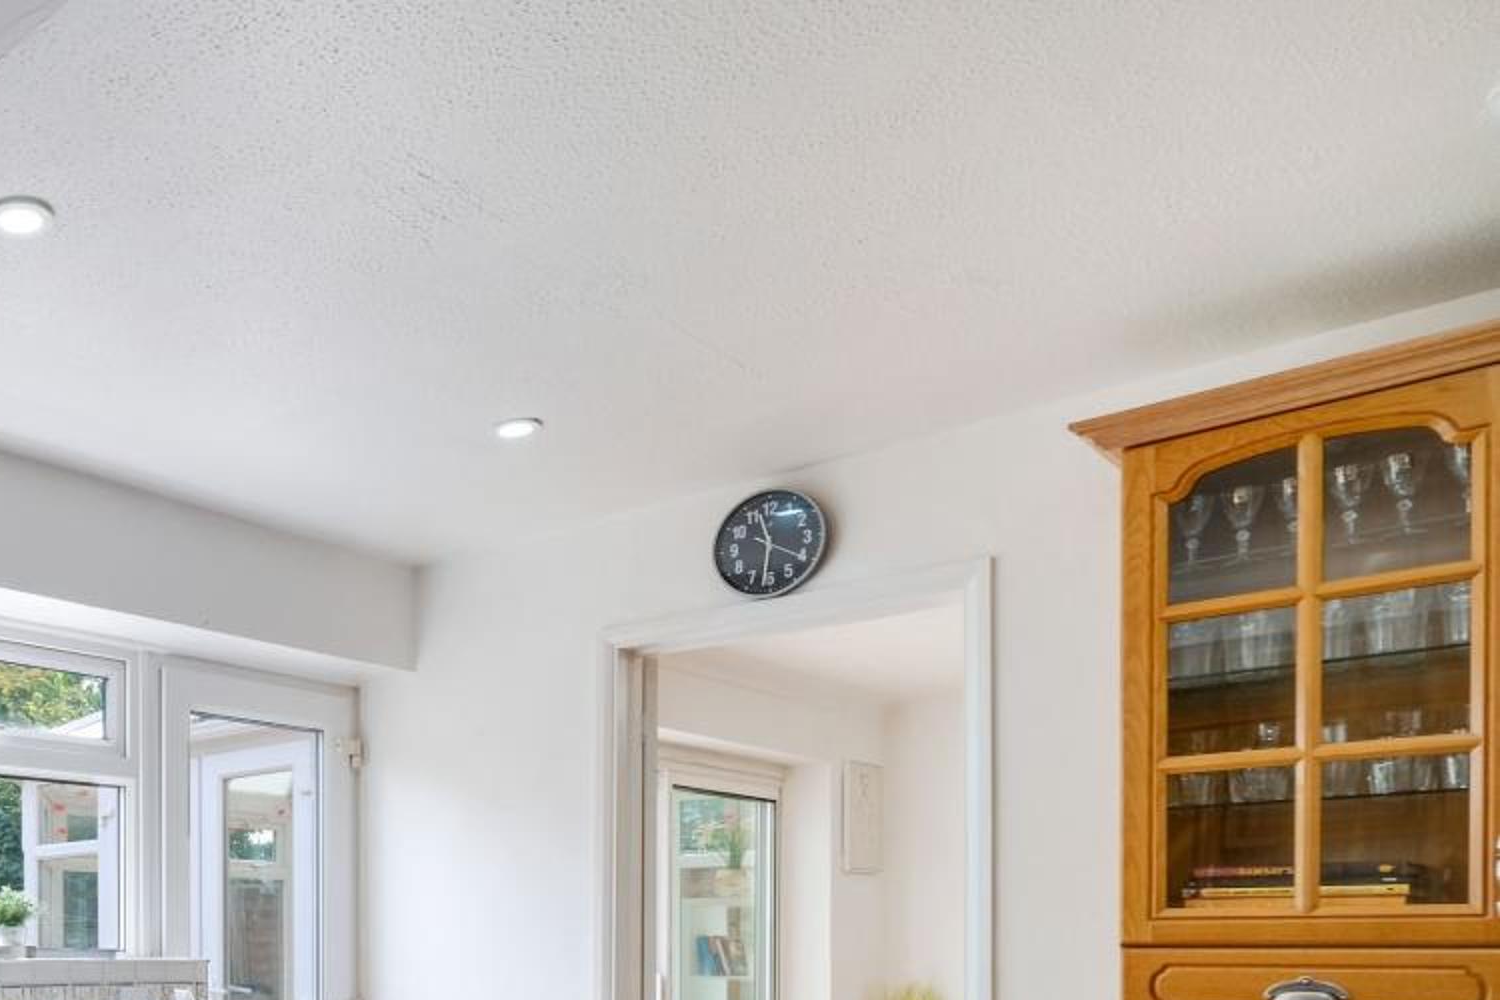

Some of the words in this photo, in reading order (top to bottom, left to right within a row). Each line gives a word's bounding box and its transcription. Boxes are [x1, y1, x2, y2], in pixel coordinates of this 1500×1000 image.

[746, 509, 759, 525] 11
[798, 513, 807, 527] 2
[733, 525, 747, 539] 10
[803, 529, 812, 544] 3
[729, 544, 739, 558] 9
[734, 560, 743, 574] 8
[784, 564, 793, 578] 5
[748, 570, 756, 585] 7
